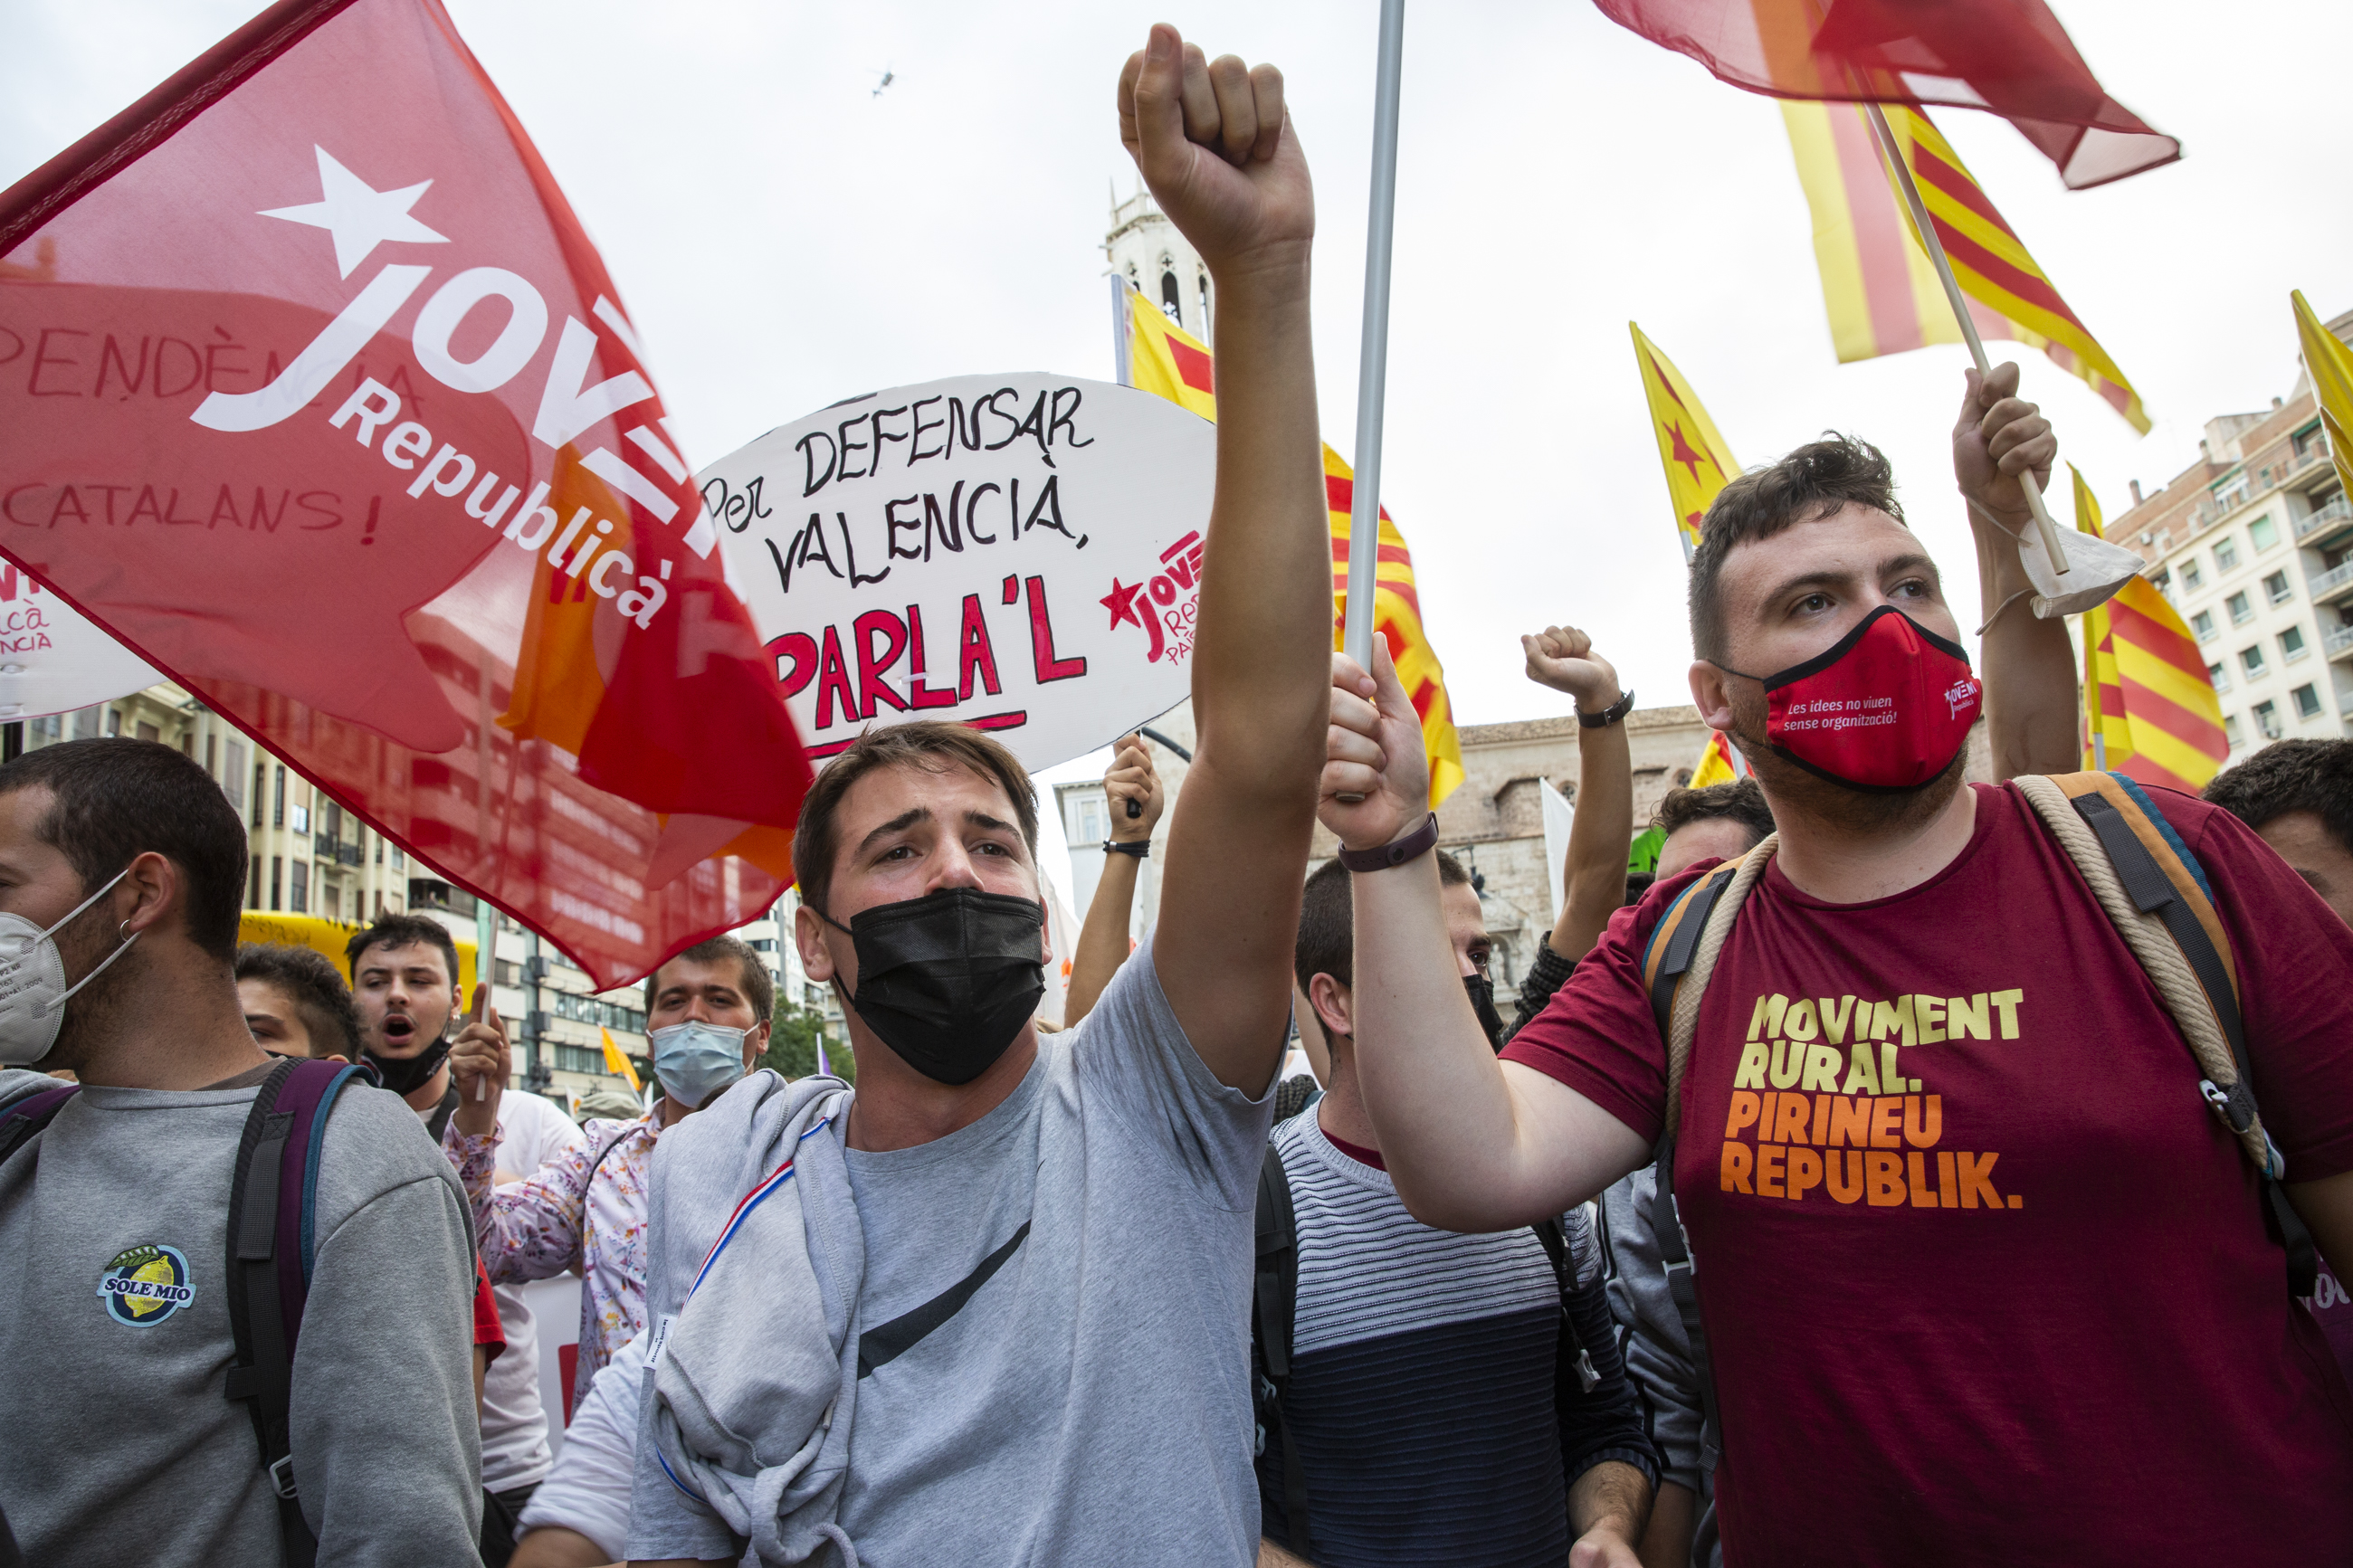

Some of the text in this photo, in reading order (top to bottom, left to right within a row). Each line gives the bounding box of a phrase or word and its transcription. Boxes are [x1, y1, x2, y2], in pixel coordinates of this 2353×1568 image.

[795, 387, 1094, 498] DEFENSAR
[329, 376, 672, 631] Republicà
[765, 453, 1089, 593] VALENCIÀ,
[0, 563, 49, 603] NT
[762, 574, 1087, 730] PARLA'L
[1784, 710, 1898, 731] sense organització!
[1788, 696, 1892, 715] Les idees no viuen
[0, 968, 10, 976] P2
[1746, 988, 2024, 1047] MOVIMENT
[1733, 1040, 1922, 1096] RURAL.
[1725, 1090, 1942, 1148] PIRINEU
[1720, 1141, 2024, 1209] REPUBLIK.
[104, 1278, 191, 1301] SOLE MIO
